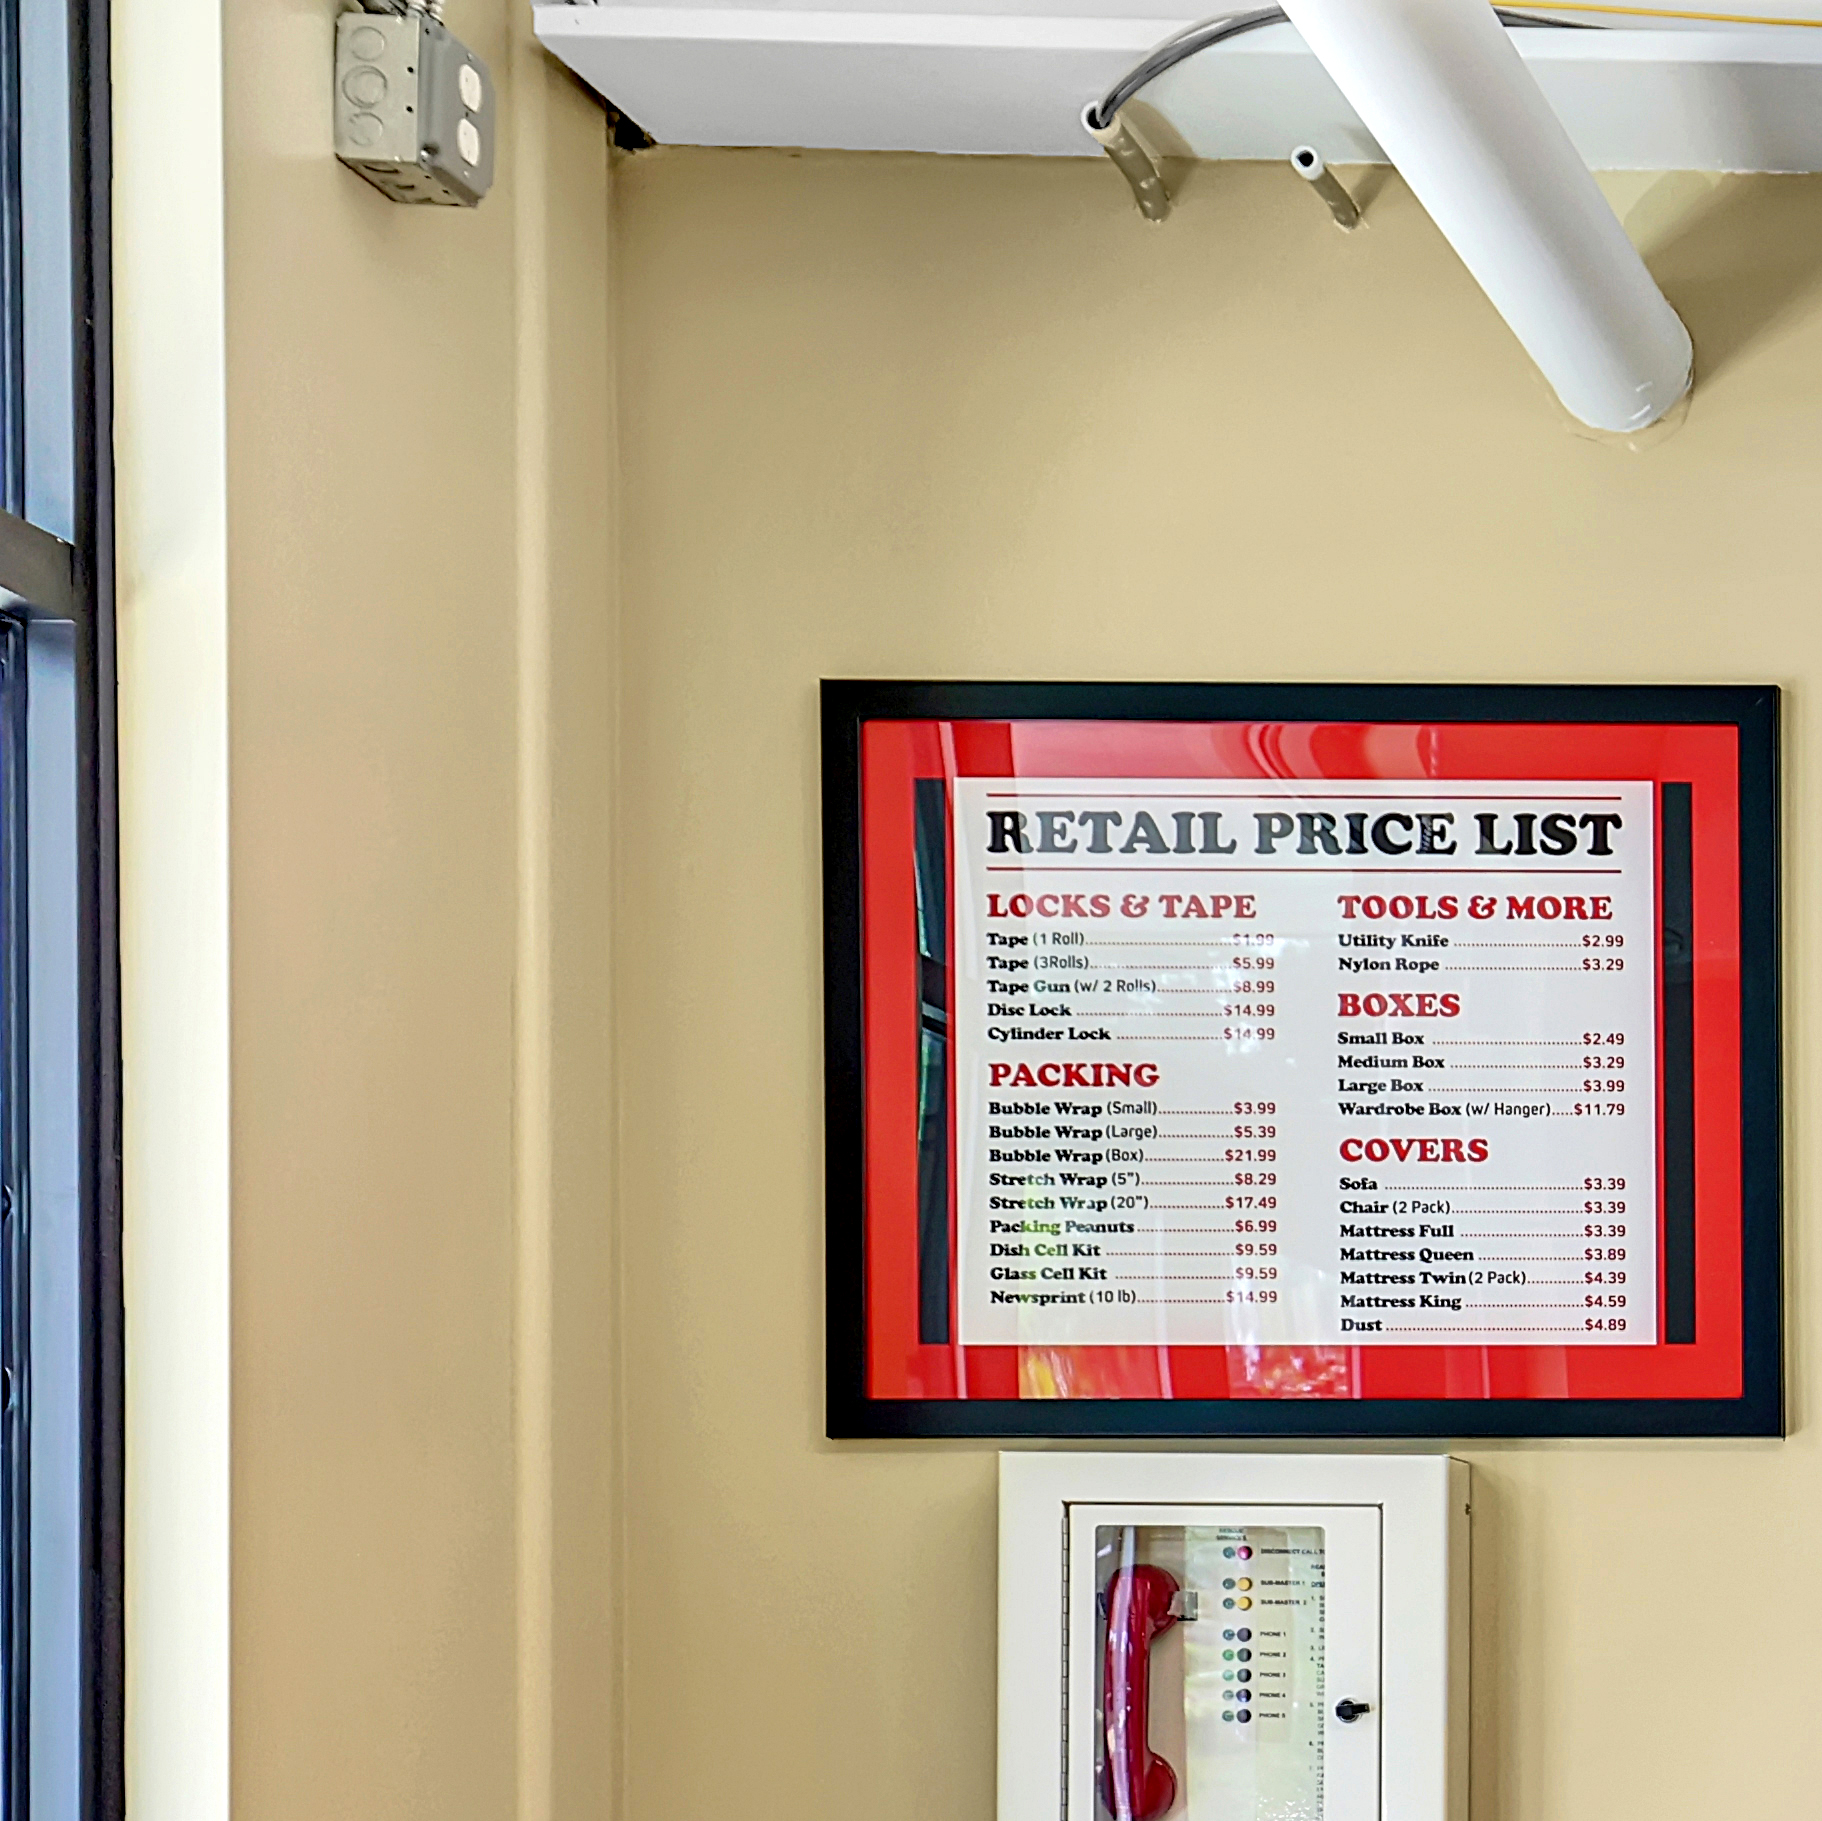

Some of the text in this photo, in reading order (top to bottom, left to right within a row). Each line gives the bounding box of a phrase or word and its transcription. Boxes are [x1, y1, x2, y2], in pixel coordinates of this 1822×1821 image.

[986, 811, 1622, 855] RETAIL PRICE LIST
[987, 894, 1256, 918] LOCKS & TAPE
[1337, 895, 1612, 920] TOOLS & MORE
[1338, 934, 1396, 949] Utility
[1402, 935, 1448, 947] Knife
[1339, 958, 1391, 973] Nylon
[1396, 958, 1439, 973] Rope
[988, 1004, 1025, 1016] Disc
[1029, 1004, 1072, 1016] Lock
[1338, 993, 1460, 1017] BOXES
[1338, 1032, 1387, 1044] Small
[1392, 1032, 1424, 1044] Box
[989, 1063, 1160, 1087] PACKING
[989, 1102, 1050, 1114] Bubble
[1054, 1102, 1102, 1118] Wrap
[1107, 1101, 1157, 1115] (Small)
[1340, 1138, 1488, 1162] COVERS
[1340, 1225, 1415, 1237] Mattress
[1419, 1225, 1454, 1237] Full
[990, 1244, 1029, 1256] Dish
[1034, 1244, 1068, 1256] Cell
[1073, 1244, 1100, 1256] Kit
[1340, 1248, 1415, 1260] Mattress
[1419, 1248, 1474, 1263] Queen
[1341, 1319, 1382, 1331] Dust
